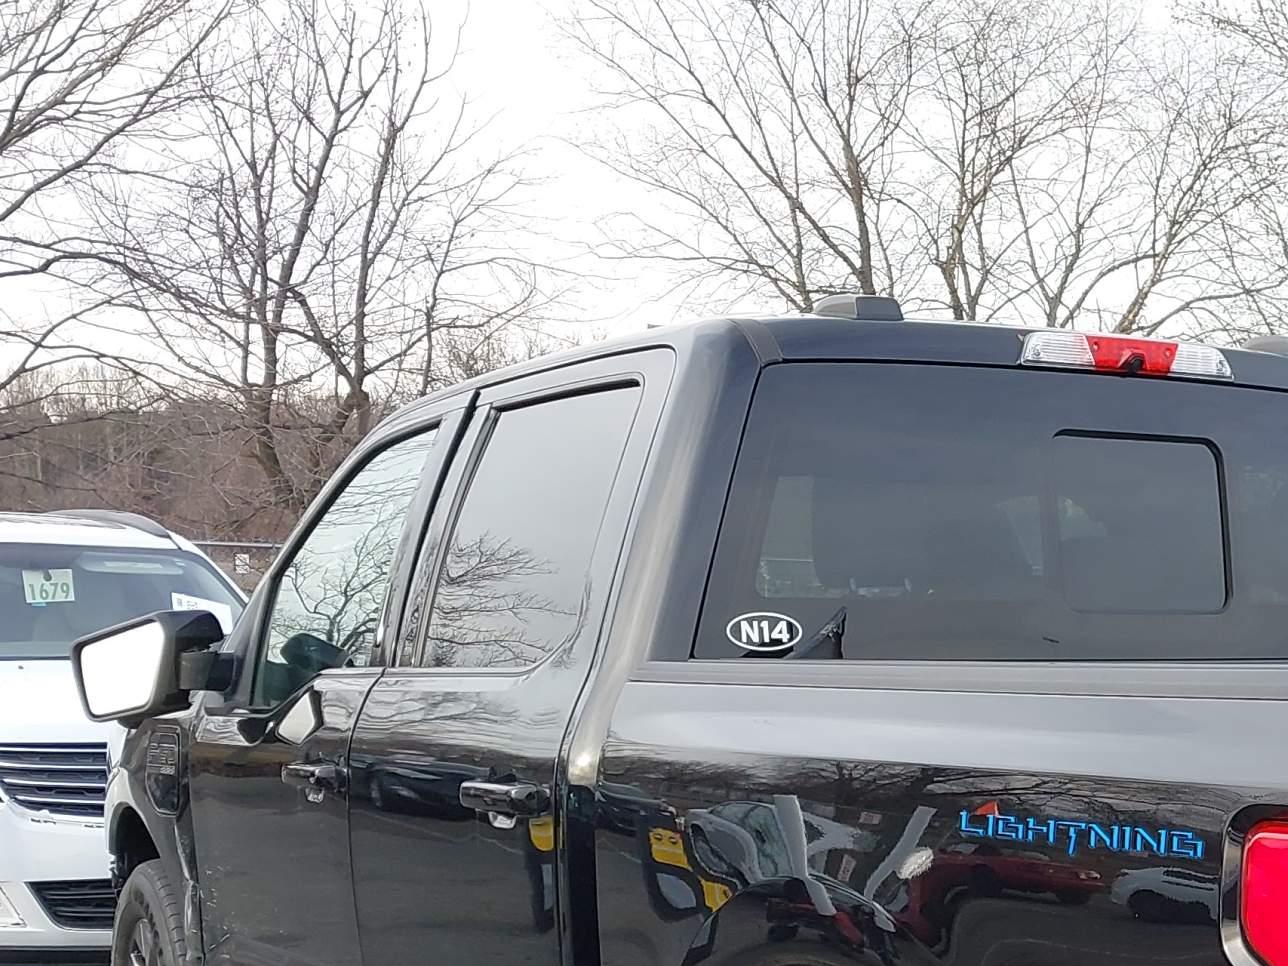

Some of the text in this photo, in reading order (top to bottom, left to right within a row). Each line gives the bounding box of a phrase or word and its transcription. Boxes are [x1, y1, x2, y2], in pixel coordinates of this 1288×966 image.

[28, 582, 71, 601] 1679
[740, 620, 790, 643] N14
[959, 808, 1205, 859] LIGHTNING
